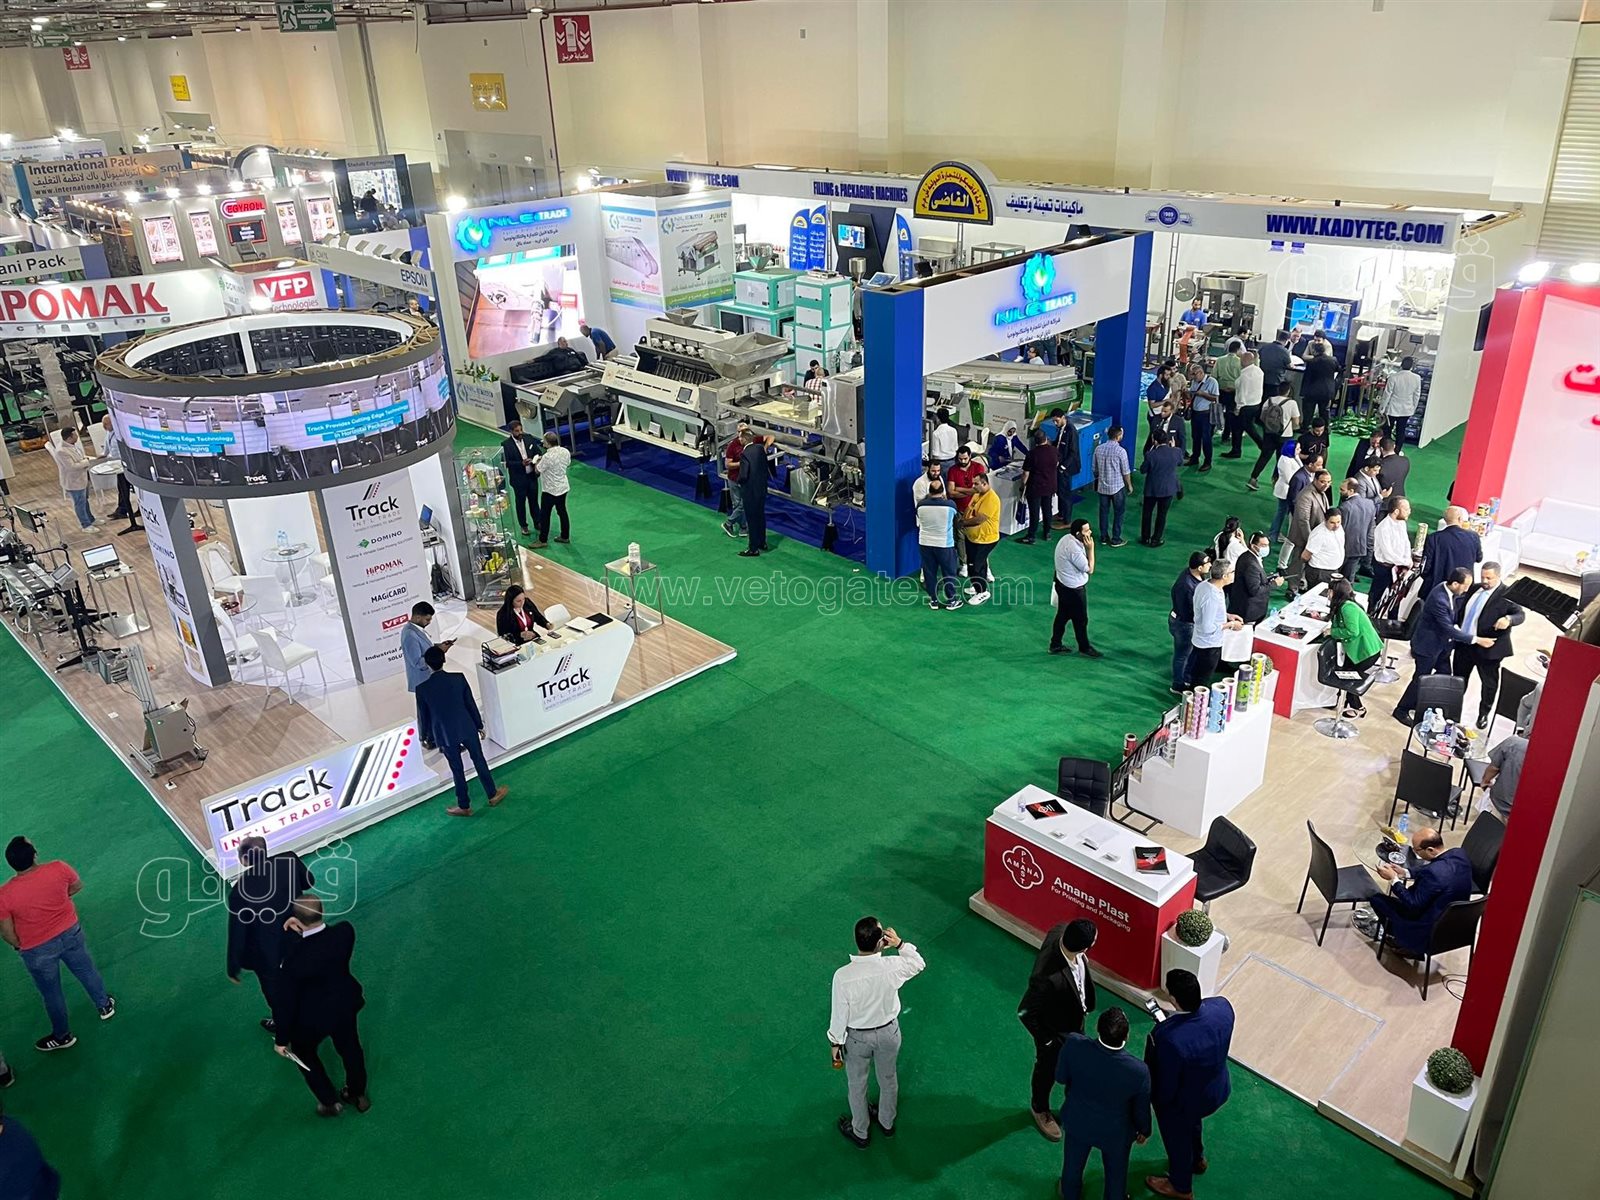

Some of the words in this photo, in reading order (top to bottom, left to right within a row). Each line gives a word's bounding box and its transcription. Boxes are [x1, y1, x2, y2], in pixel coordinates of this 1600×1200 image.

[29, 158, 108, 175] International
[110, 156, 138, 168] Pack
[814, 181, 834, 196] FILLING
[835, 186, 840, 197] &
[840, 183, 875, 199] PACKAGING
[875, 185, 908, 202] MACHINES
[227, 202, 265, 213] EGYROLL
[538, 208, 568, 221] TRADE
[1054, 198, 1084, 218] ماكينات
[1266, 214, 1445, 244] WWW.KADYTEC.COM
[26, 254, 66, 270] Pack
[259, 277, 308, 299] VFP
[400, 268, 428, 288] EPSON
[0, 282, 168, 321] POMAK
[1045, 294, 1075, 312] TRADE
[325, 421, 351, 429] Provides
[351, 417, 371, 427] Cutting
[371, 412, 384, 420] Edge
[161, 434, 180, 442] Cutting
[196, 435, 234, 443] Technology
[245, 474, 267, 482] Track
[345, 496, 399, 521] Track
[371, 530, 402, 544] DOMINO
[384, 615, 408, 627] VFP
[365, 648, 397, 661] Industrial
[537, 667, 590, 698] Track
[567, 682, 591, 695] TRADE
[211, 768, 334, 832] Track
[279, 798, 332, 826] TRADE
[1007, 857, 1039, 879] AMANA
[1051, 885, 1061, 895] For
[1062, 891, 1085, 908] Printing
[1086, 903, 1098, 914] and
[1098, 910, 1131, 932] Packaging
[1054, 877, 1095, 905] Amana
[1098, 899, 1130, 923] Plast
